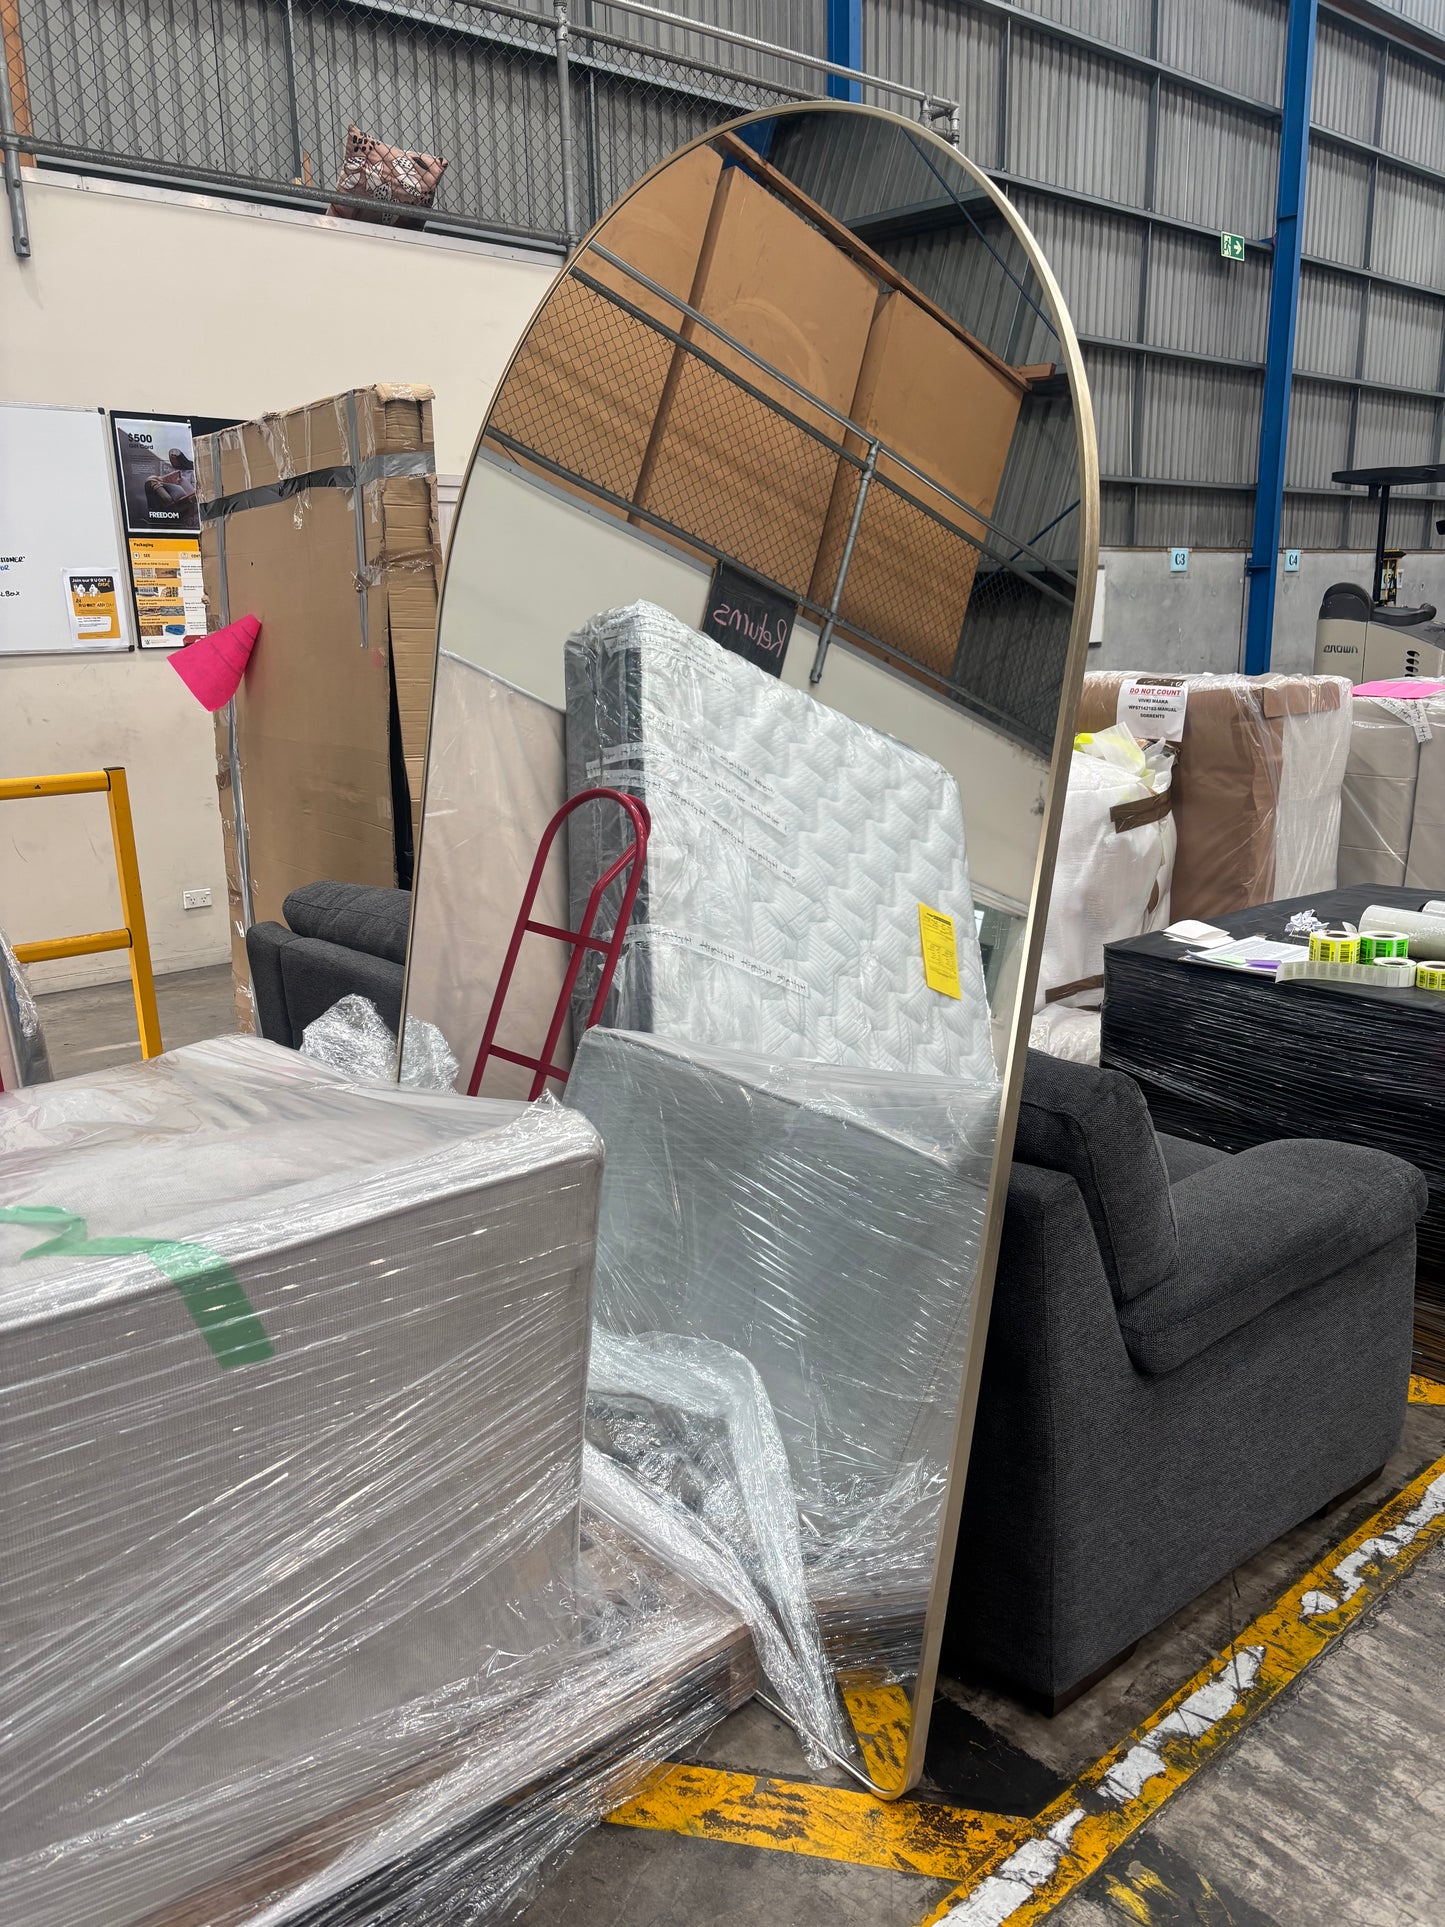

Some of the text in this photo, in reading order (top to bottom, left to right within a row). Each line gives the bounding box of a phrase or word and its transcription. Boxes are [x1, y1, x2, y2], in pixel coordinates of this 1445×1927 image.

[128, 433, 152, 443] $500
[149, 511, 180, 519] FREEDOM
[1175, 553, 1186, 566] C3
[1288, 554, 1298, 566] C4
